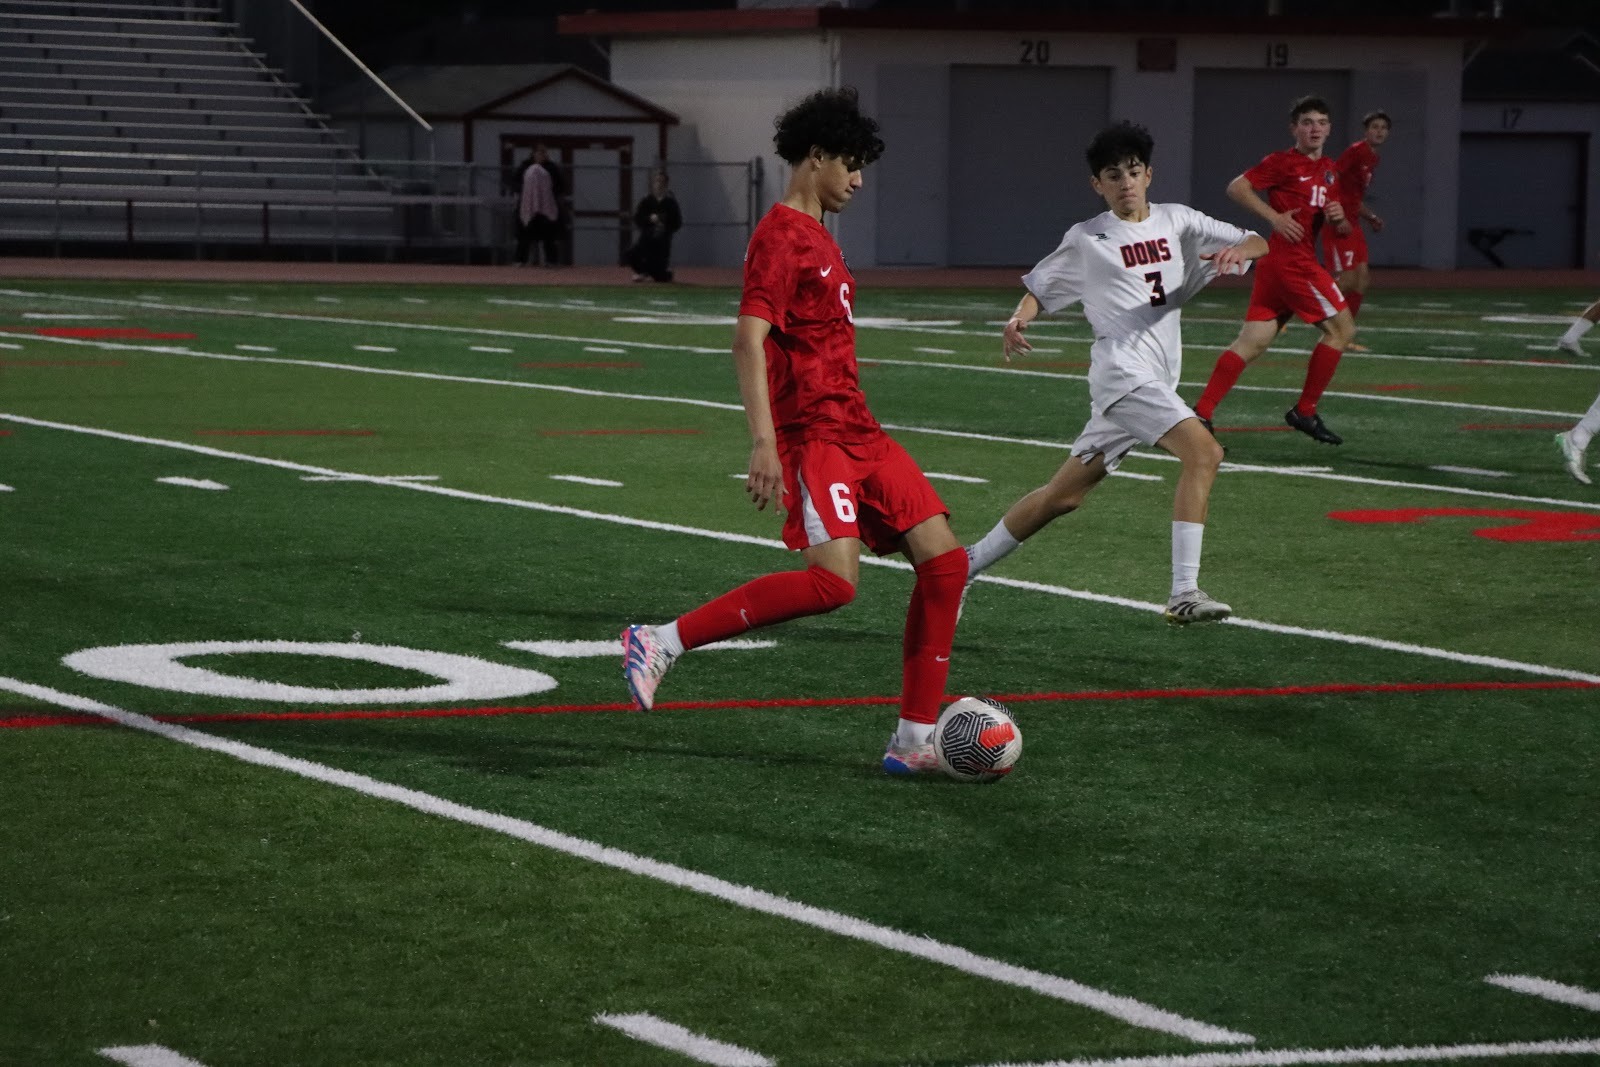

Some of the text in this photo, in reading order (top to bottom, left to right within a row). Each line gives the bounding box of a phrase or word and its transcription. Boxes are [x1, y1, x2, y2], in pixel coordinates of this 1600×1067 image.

[1021, 39, 1050, 64] 20
[1266, 43, 1289, 67] 19
[1503, 107, 1522, 129] 17
[1309, 184, 1328, 208] 16
[1119, 237, 1172, 269] DONS
[1344, 250, 1355, 267] 7
[1144, 270, 1167, 307] 3
[828, 482, 857, 523] 6
